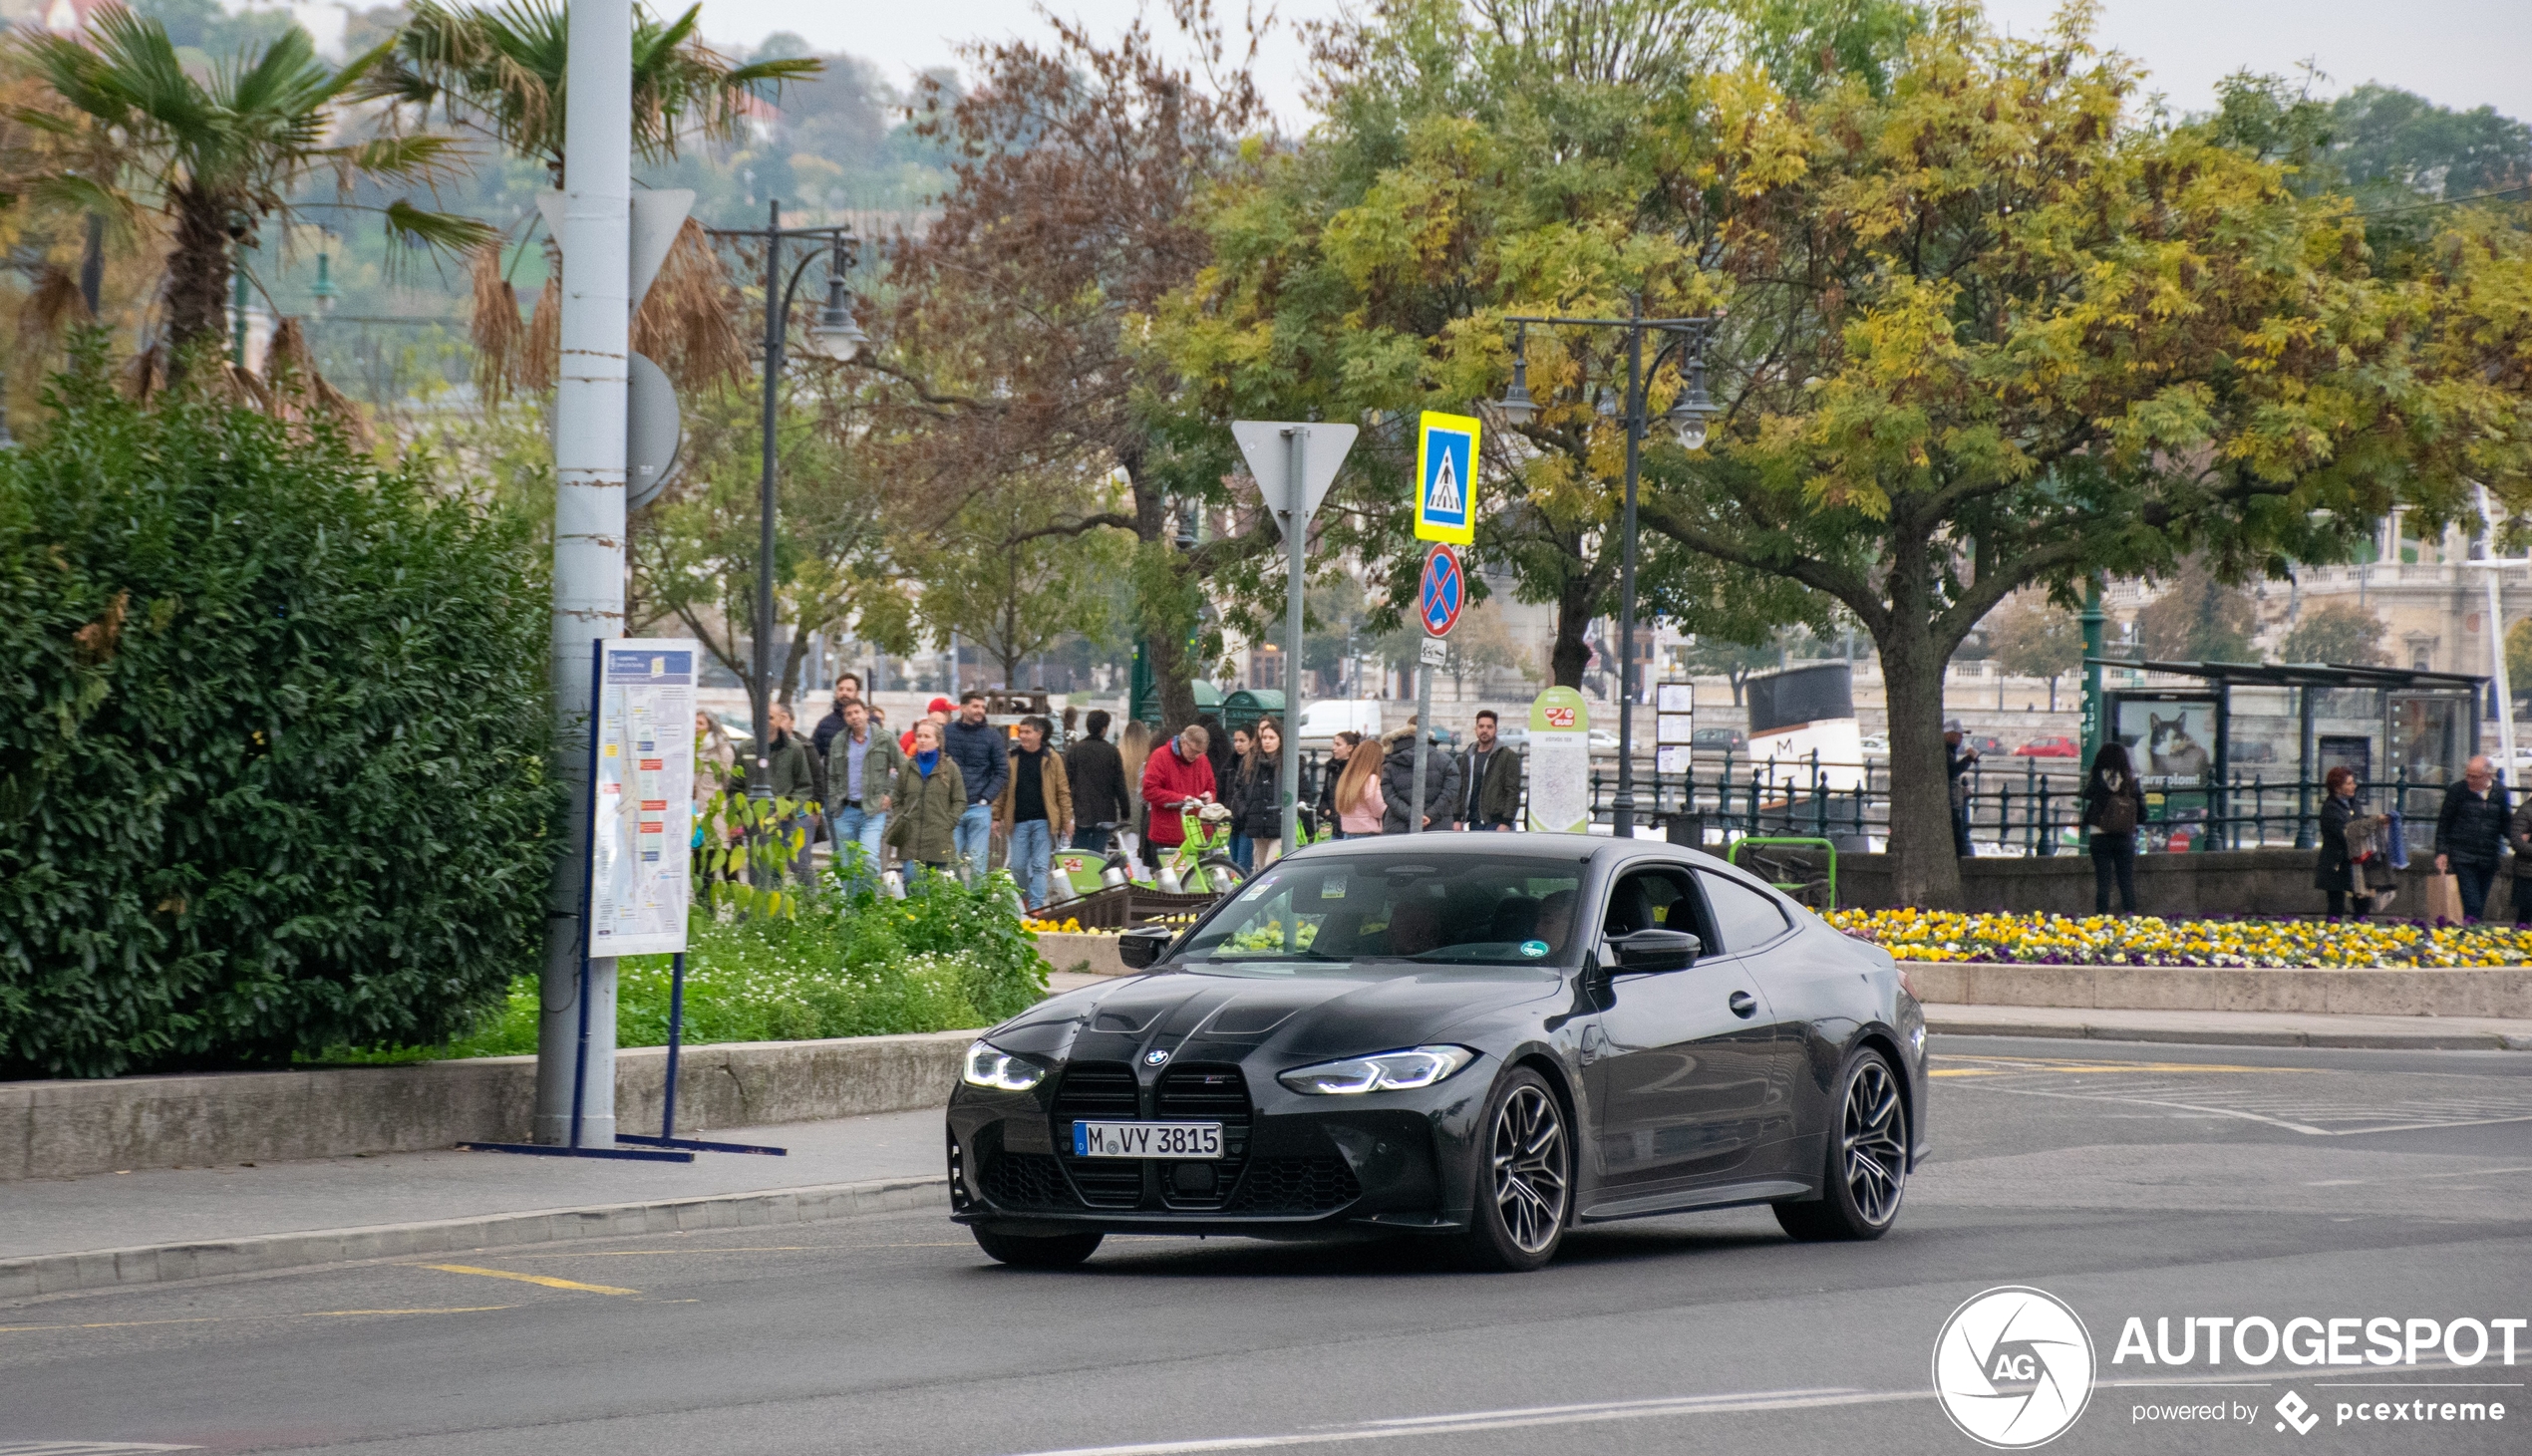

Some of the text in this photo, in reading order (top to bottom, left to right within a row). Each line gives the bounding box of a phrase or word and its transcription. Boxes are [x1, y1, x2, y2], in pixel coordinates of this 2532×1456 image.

[1088, 1127, 1218, 1154] M VY 3815
